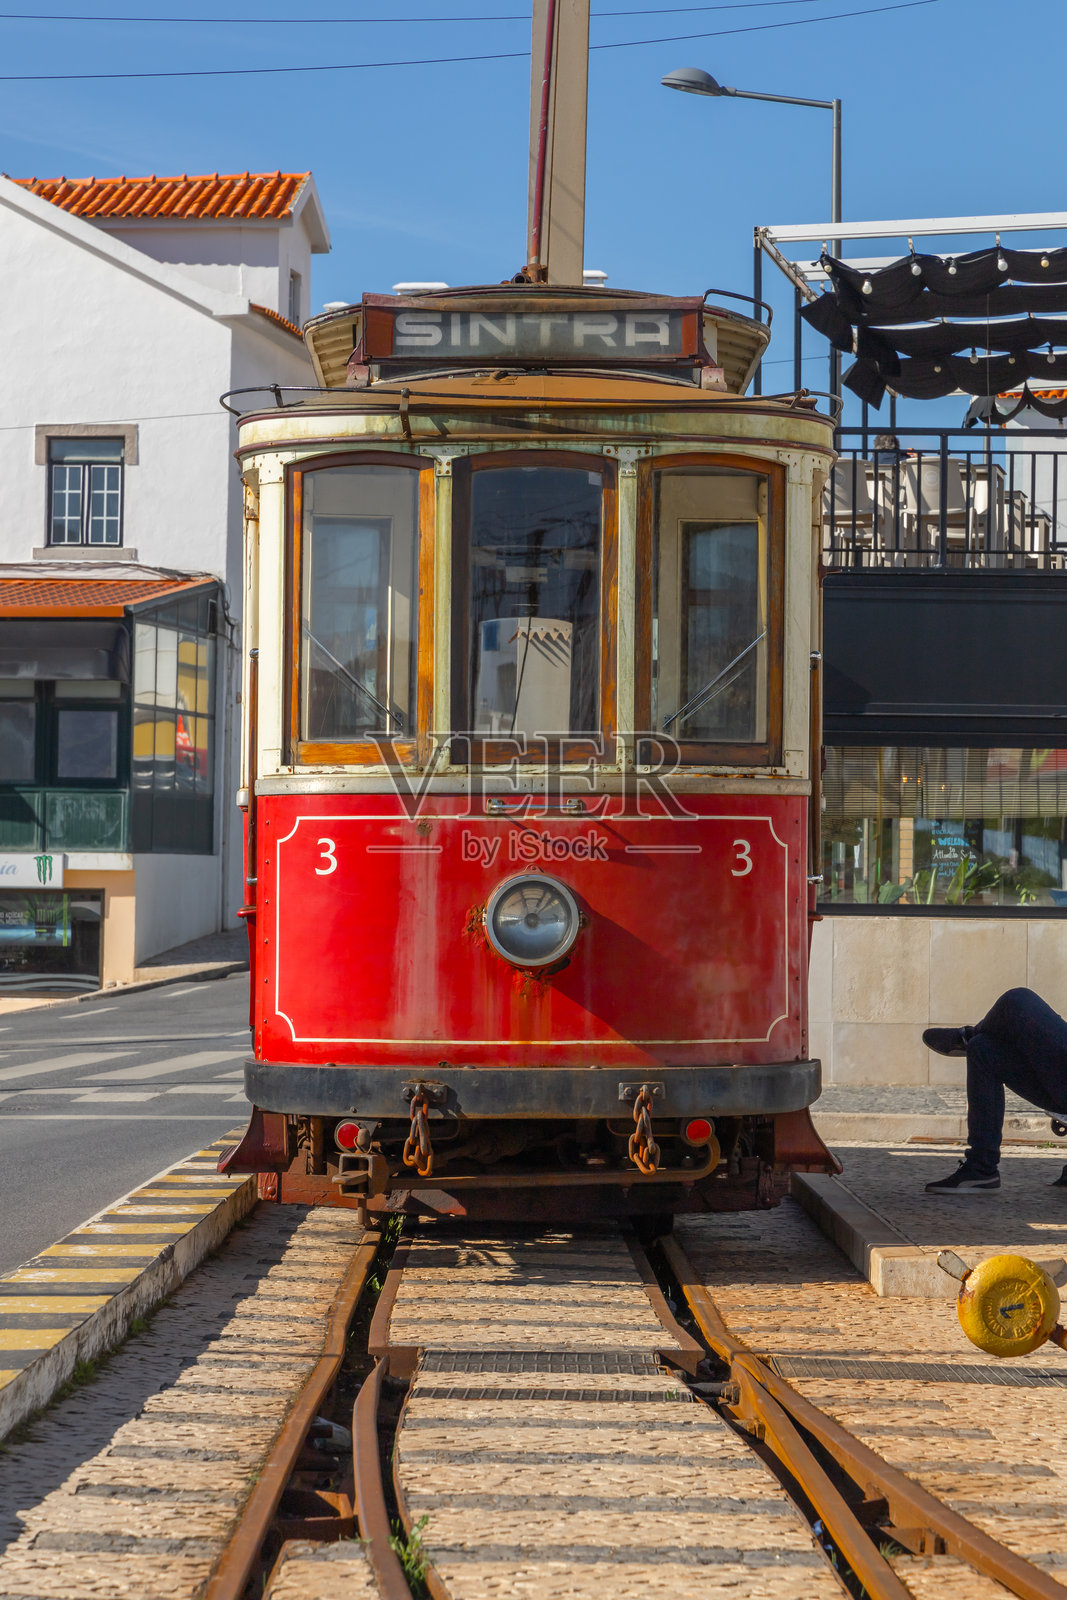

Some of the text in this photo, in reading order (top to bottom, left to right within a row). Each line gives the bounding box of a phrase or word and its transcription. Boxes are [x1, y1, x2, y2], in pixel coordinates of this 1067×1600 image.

[395, 312, 670, 347] SINTRA
[314, 837, 339, 876] 3
[731, 838, 754, 877] 3
